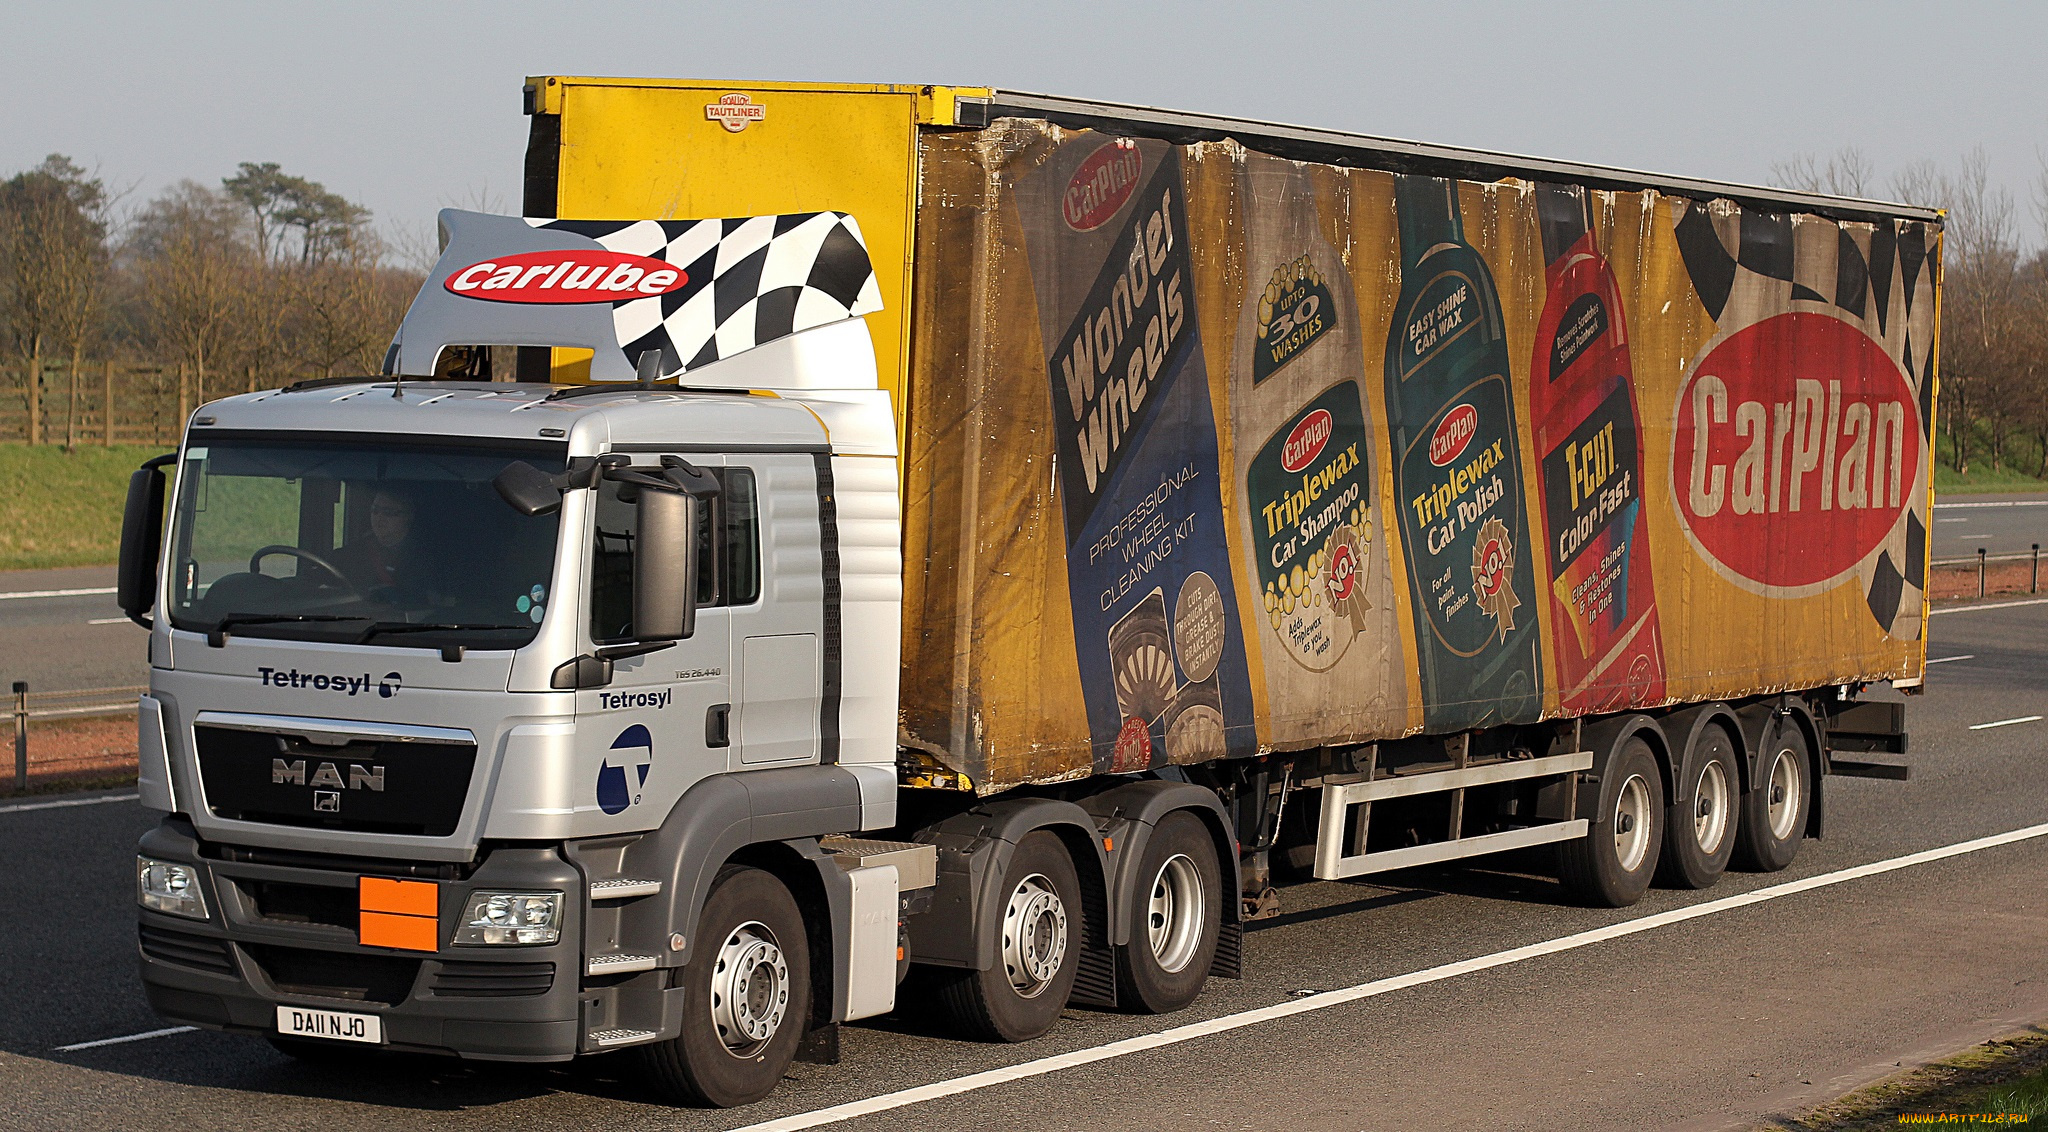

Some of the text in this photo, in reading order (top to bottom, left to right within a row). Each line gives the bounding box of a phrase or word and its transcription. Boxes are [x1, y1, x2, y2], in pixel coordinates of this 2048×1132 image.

[708, 107, 762, 117] TAUTLINER
[1066, 149, 1139, 224] CarPlan
[452, 261, 679, 294] Carlube
[1062, 187, 1174, 422] Wonder
[1270, 295, 1320, 346] 30
[1409, 285, 1467, 342] EASY SHINE
[1271, 314, 1322, 363] WASHES
[1414, 307, 1463, 356] CAR WAX
[1077, 268, 1185, 493] Wheels
[1284, 417, 1329, 468] CarPlan
[1431, 411, 1475, 459] CarPlan
[1689, 375, 1905, 517] CarPlan
[1262, 441, 1360, 538] Triplewax
[1412, 437, 1505, 530] Triplewax
[1088, 462, 1200, 565] PROFESSIONAL
[1121, 511, 1171, 564] WHEEL
[1271, 482, 1360, 569] Car Shampoo
[1427, 518, 1456, 556] Car
[1457, 473, 1505, 532] Polish
[1559, 470, 1631, 563] Color Fast
[1100, 512, 1197, 612] CLEANING KIT
[1432, 566, 1452, 593] For all
[1572, 541, 1626, 604] Cleans, Shines
[1187, 586, 1202, 608] CUTS
[1438, 585, 1455, 611] paint
[1446, 593, 1469, 622] finishes
[1579, 564, 1622, 616] & Restores
[1589, 592, 1613, 625] In One
[1176, 602, 1203, 635] THROUGH
[1184, 621, 1221, 662] BRAKE DUST
[1185, 614, 1208, 644] GREASE
[1289, 616, 1303, 638] Adds
[1293, 616, 1322, 647] Triplewax
[1304, 630, 1322, 653] as you
[1189, 639, 1220, 674] INSTANTLY
[1316, 636, 1331, 657] wash
[258, 667, 370, 697] Tetrosyl
[600, 688, 672, 709] Tetrosyl
[272, 757, 385, 791] MAN
[330, 1015, 365, 1037] NJO
